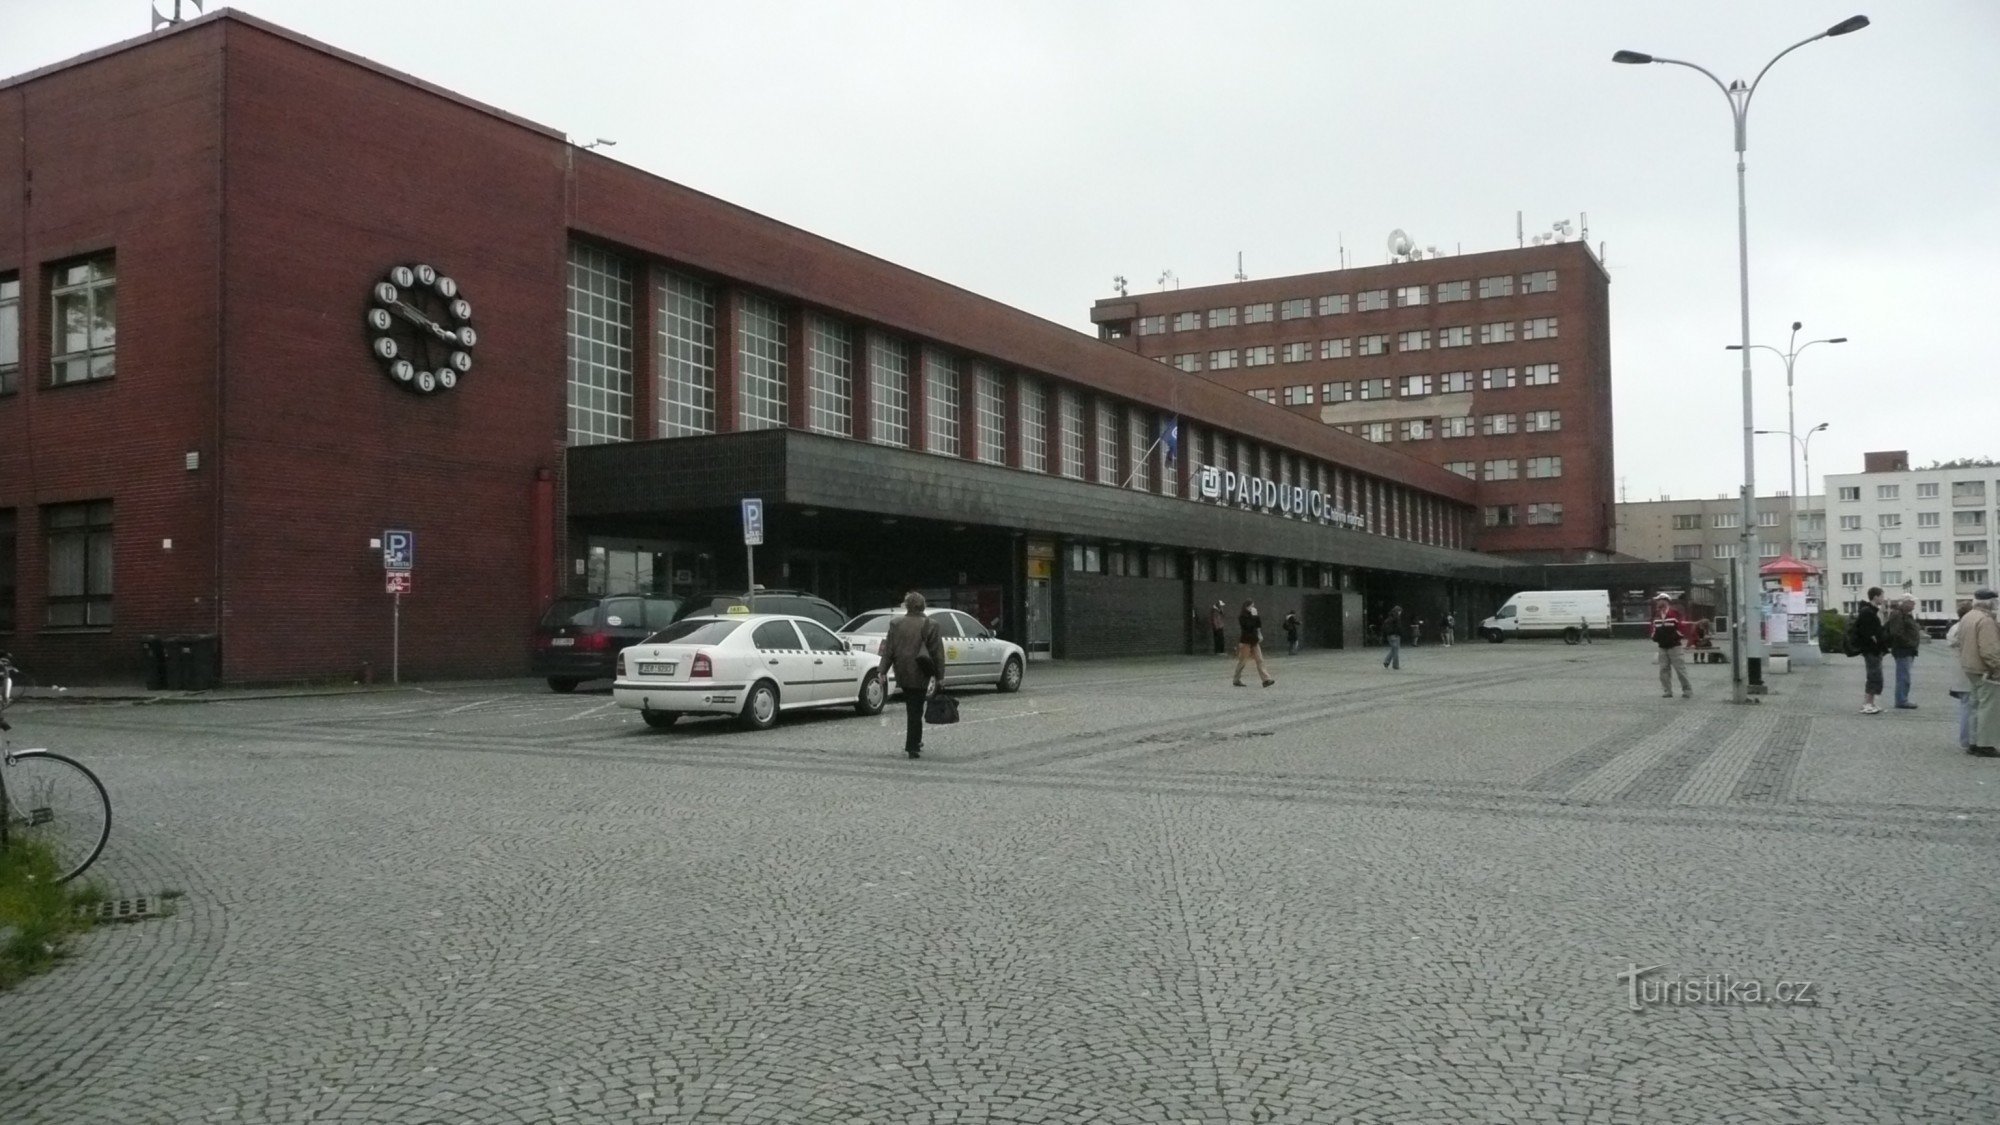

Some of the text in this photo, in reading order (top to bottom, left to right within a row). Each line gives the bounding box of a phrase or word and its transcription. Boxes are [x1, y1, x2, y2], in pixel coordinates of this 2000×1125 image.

[402, 269, 409, 285] 11
[423, 267, 432, 282] 12
[385, 286, 394, 301] 10
[461, 302, 467, 317] 2
[379, 312, 386, 326] 9
[466, 330, 472, 344] 3
[386, 340, 392, 355] 8
[459, 354, 467, 368] 4
[402, 363, 409, 378] 7
[445, 371, 452, 385] 5
[424, 374, 430, 389] 6
[1371, 414, 1549, 441] HOTEL
[1226, 471, 1331, 519] PARDUBICE
[747, 505, 759, 530] P
[390, 534, 406, 557] P
